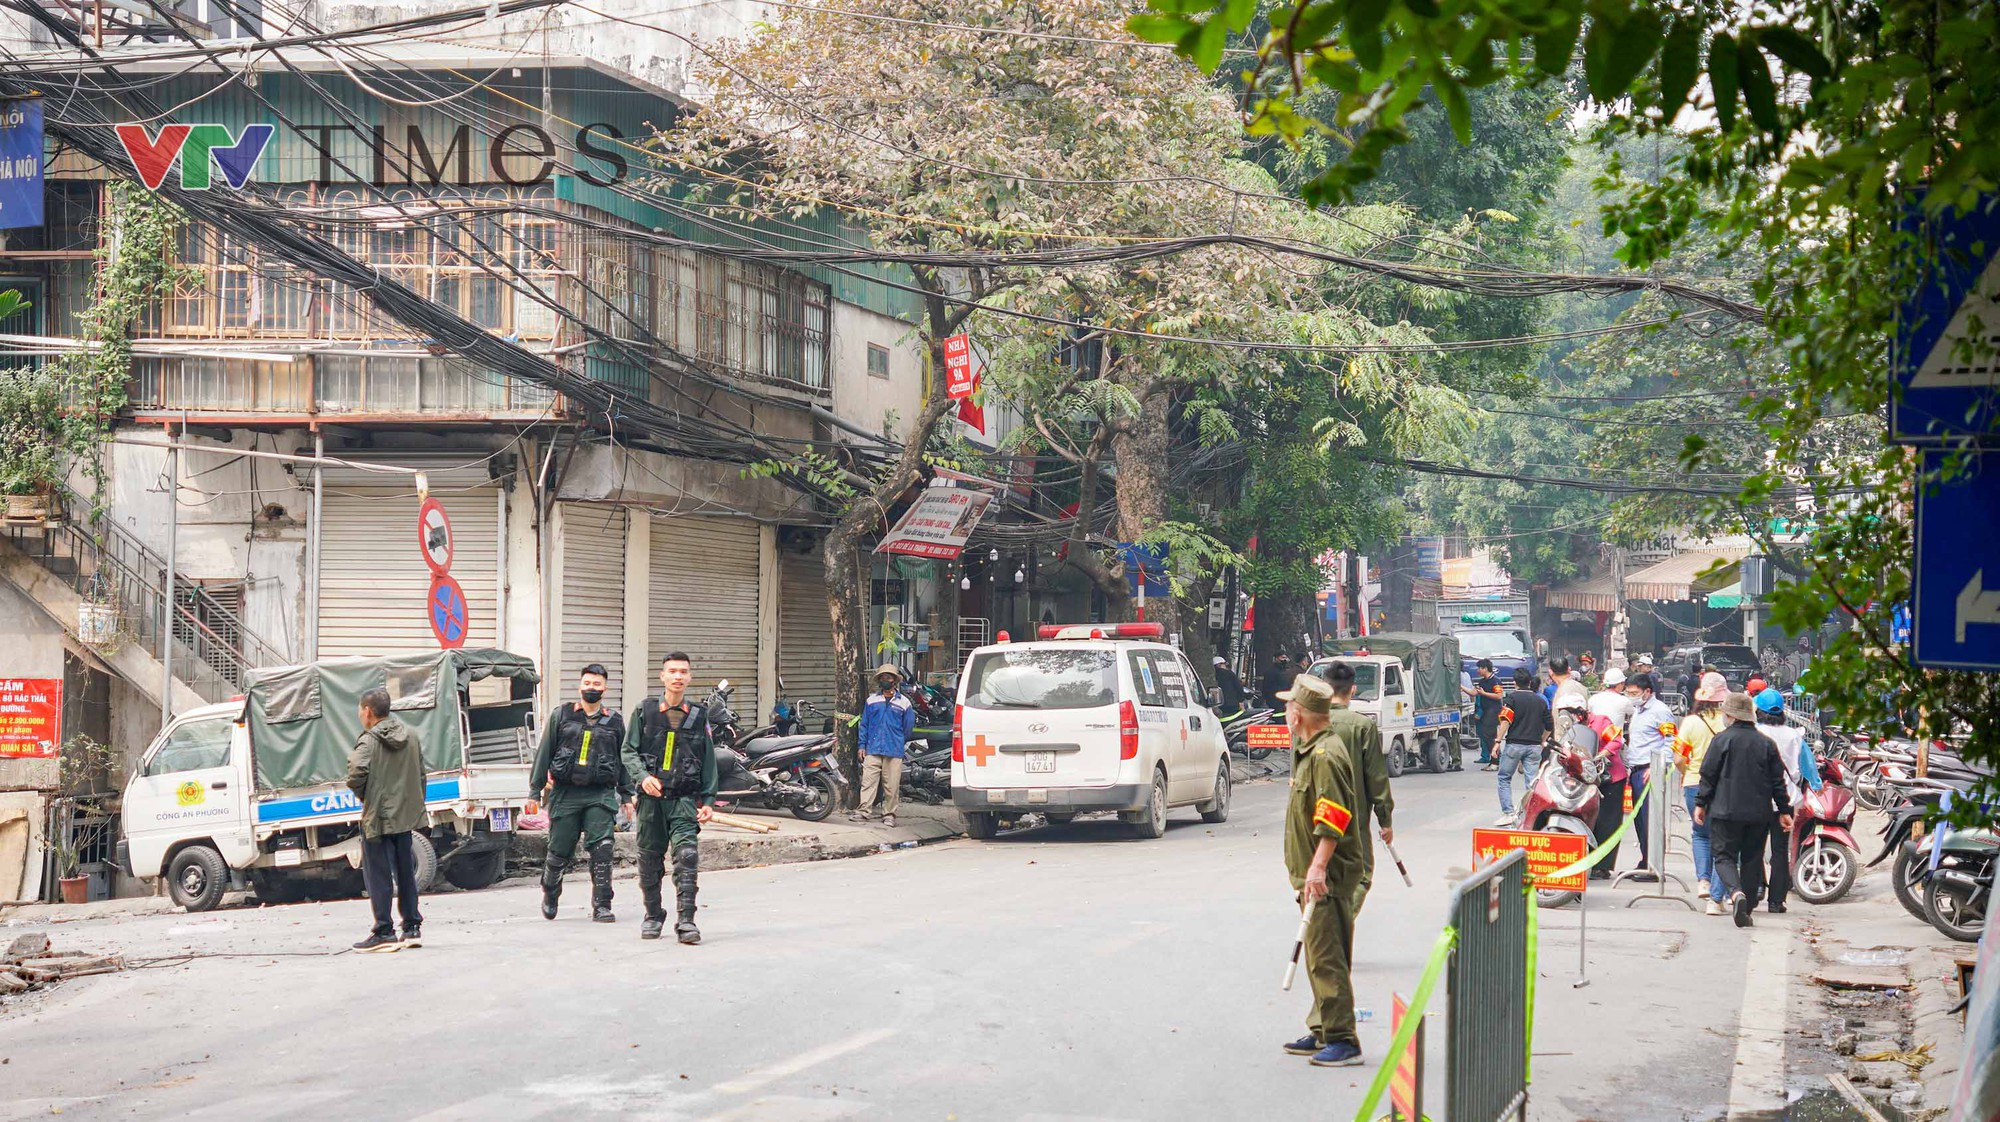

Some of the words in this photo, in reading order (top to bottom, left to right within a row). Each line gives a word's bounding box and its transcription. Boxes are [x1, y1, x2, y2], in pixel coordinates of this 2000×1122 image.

[15, 154, 37, 181] NỘI
[948, 337, 966, 353] NHÀ
[1509, 836, 1529, 846] KHU
[1531, 837, 1550, 850] VỰC
[1559, 851, 1580, 863] CHẾ
